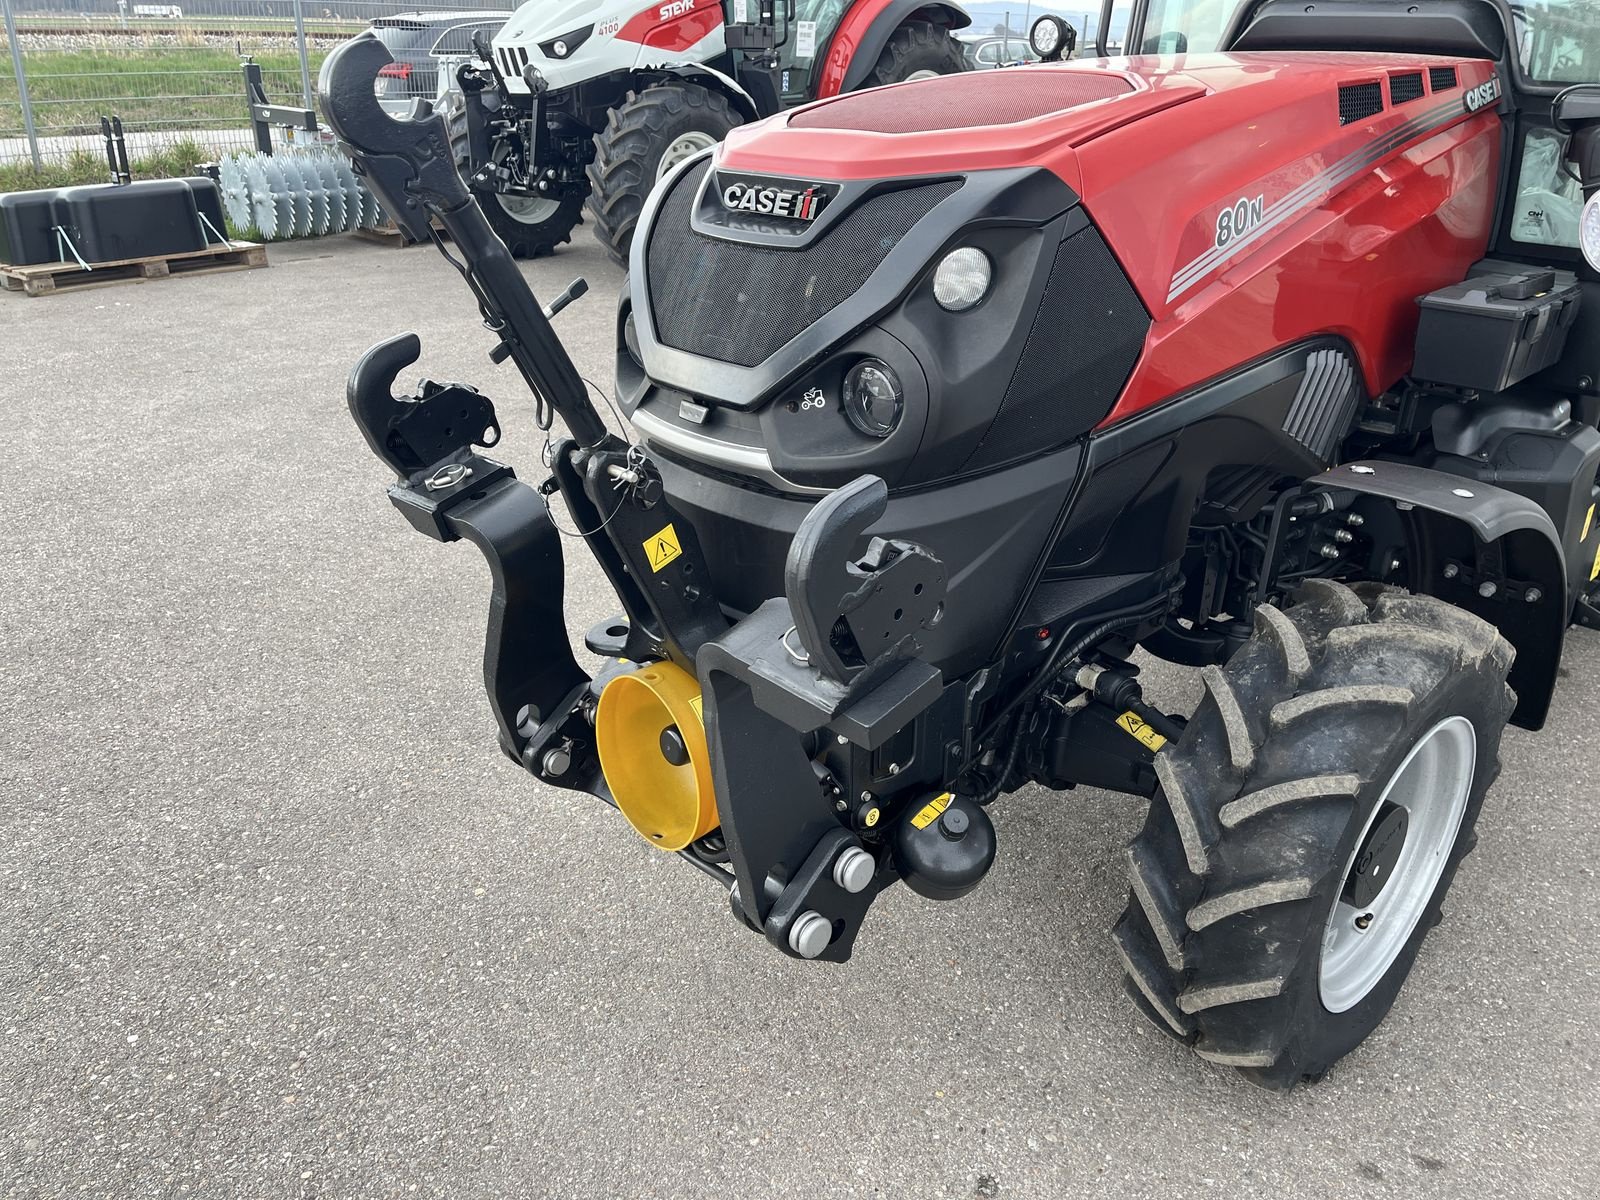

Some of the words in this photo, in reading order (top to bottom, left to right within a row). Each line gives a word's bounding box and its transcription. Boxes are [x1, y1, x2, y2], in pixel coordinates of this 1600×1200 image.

[660, 0, 695, 21] STEYR
[599, 23, 619, 36] 4100
[1466, 81, 1494, 111] CASE
[724, 186, 793, 216] CASE
[1215, 193, 1264, 250] 80N
